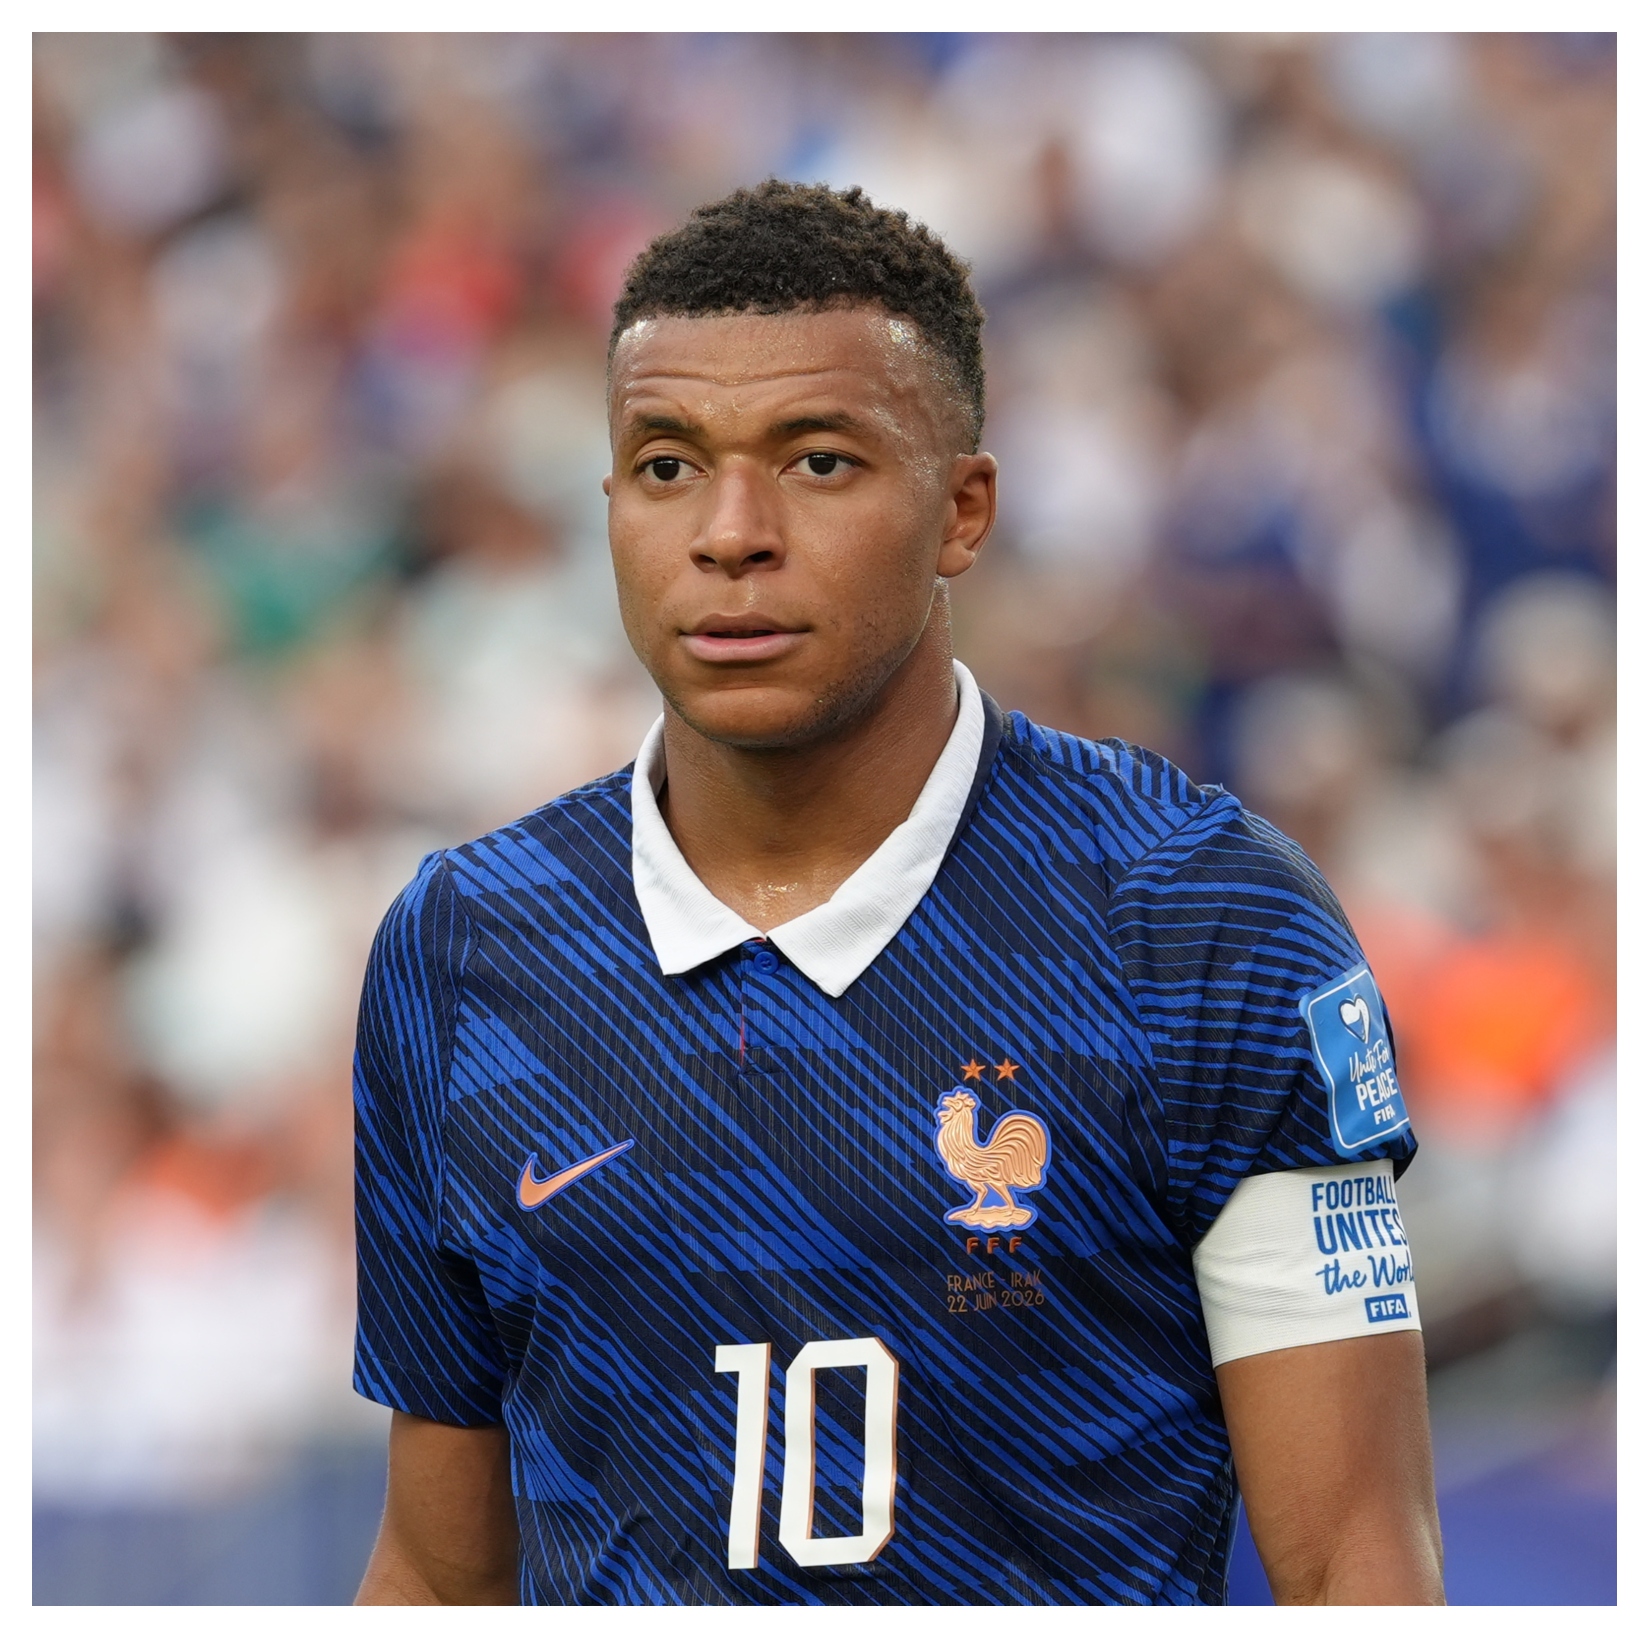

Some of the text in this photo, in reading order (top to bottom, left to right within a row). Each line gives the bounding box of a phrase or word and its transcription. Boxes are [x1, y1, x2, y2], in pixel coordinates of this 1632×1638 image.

[1349, 1048, 1377, 1083] Unite
[1355, 1067, 1398, 1111] PEACE
[1373, 1103, 1396, 1125] FIFA
[1311, 1175, 1396, 1213] FOOTBALL
[1313, 1208, 1408, 1255] UNITES
[947, 1270, 995, 1293] FRANCE
[1011, 1269, 1042, 1288] IRAK
[1315, 1249, 1414, 1295] the Worl
[947, 1287, 1045, 1313] 22 JUIN 2026
[1369, 1298, 1406, 1318] FIFA
[714, 1336, 900, 1570] 10
